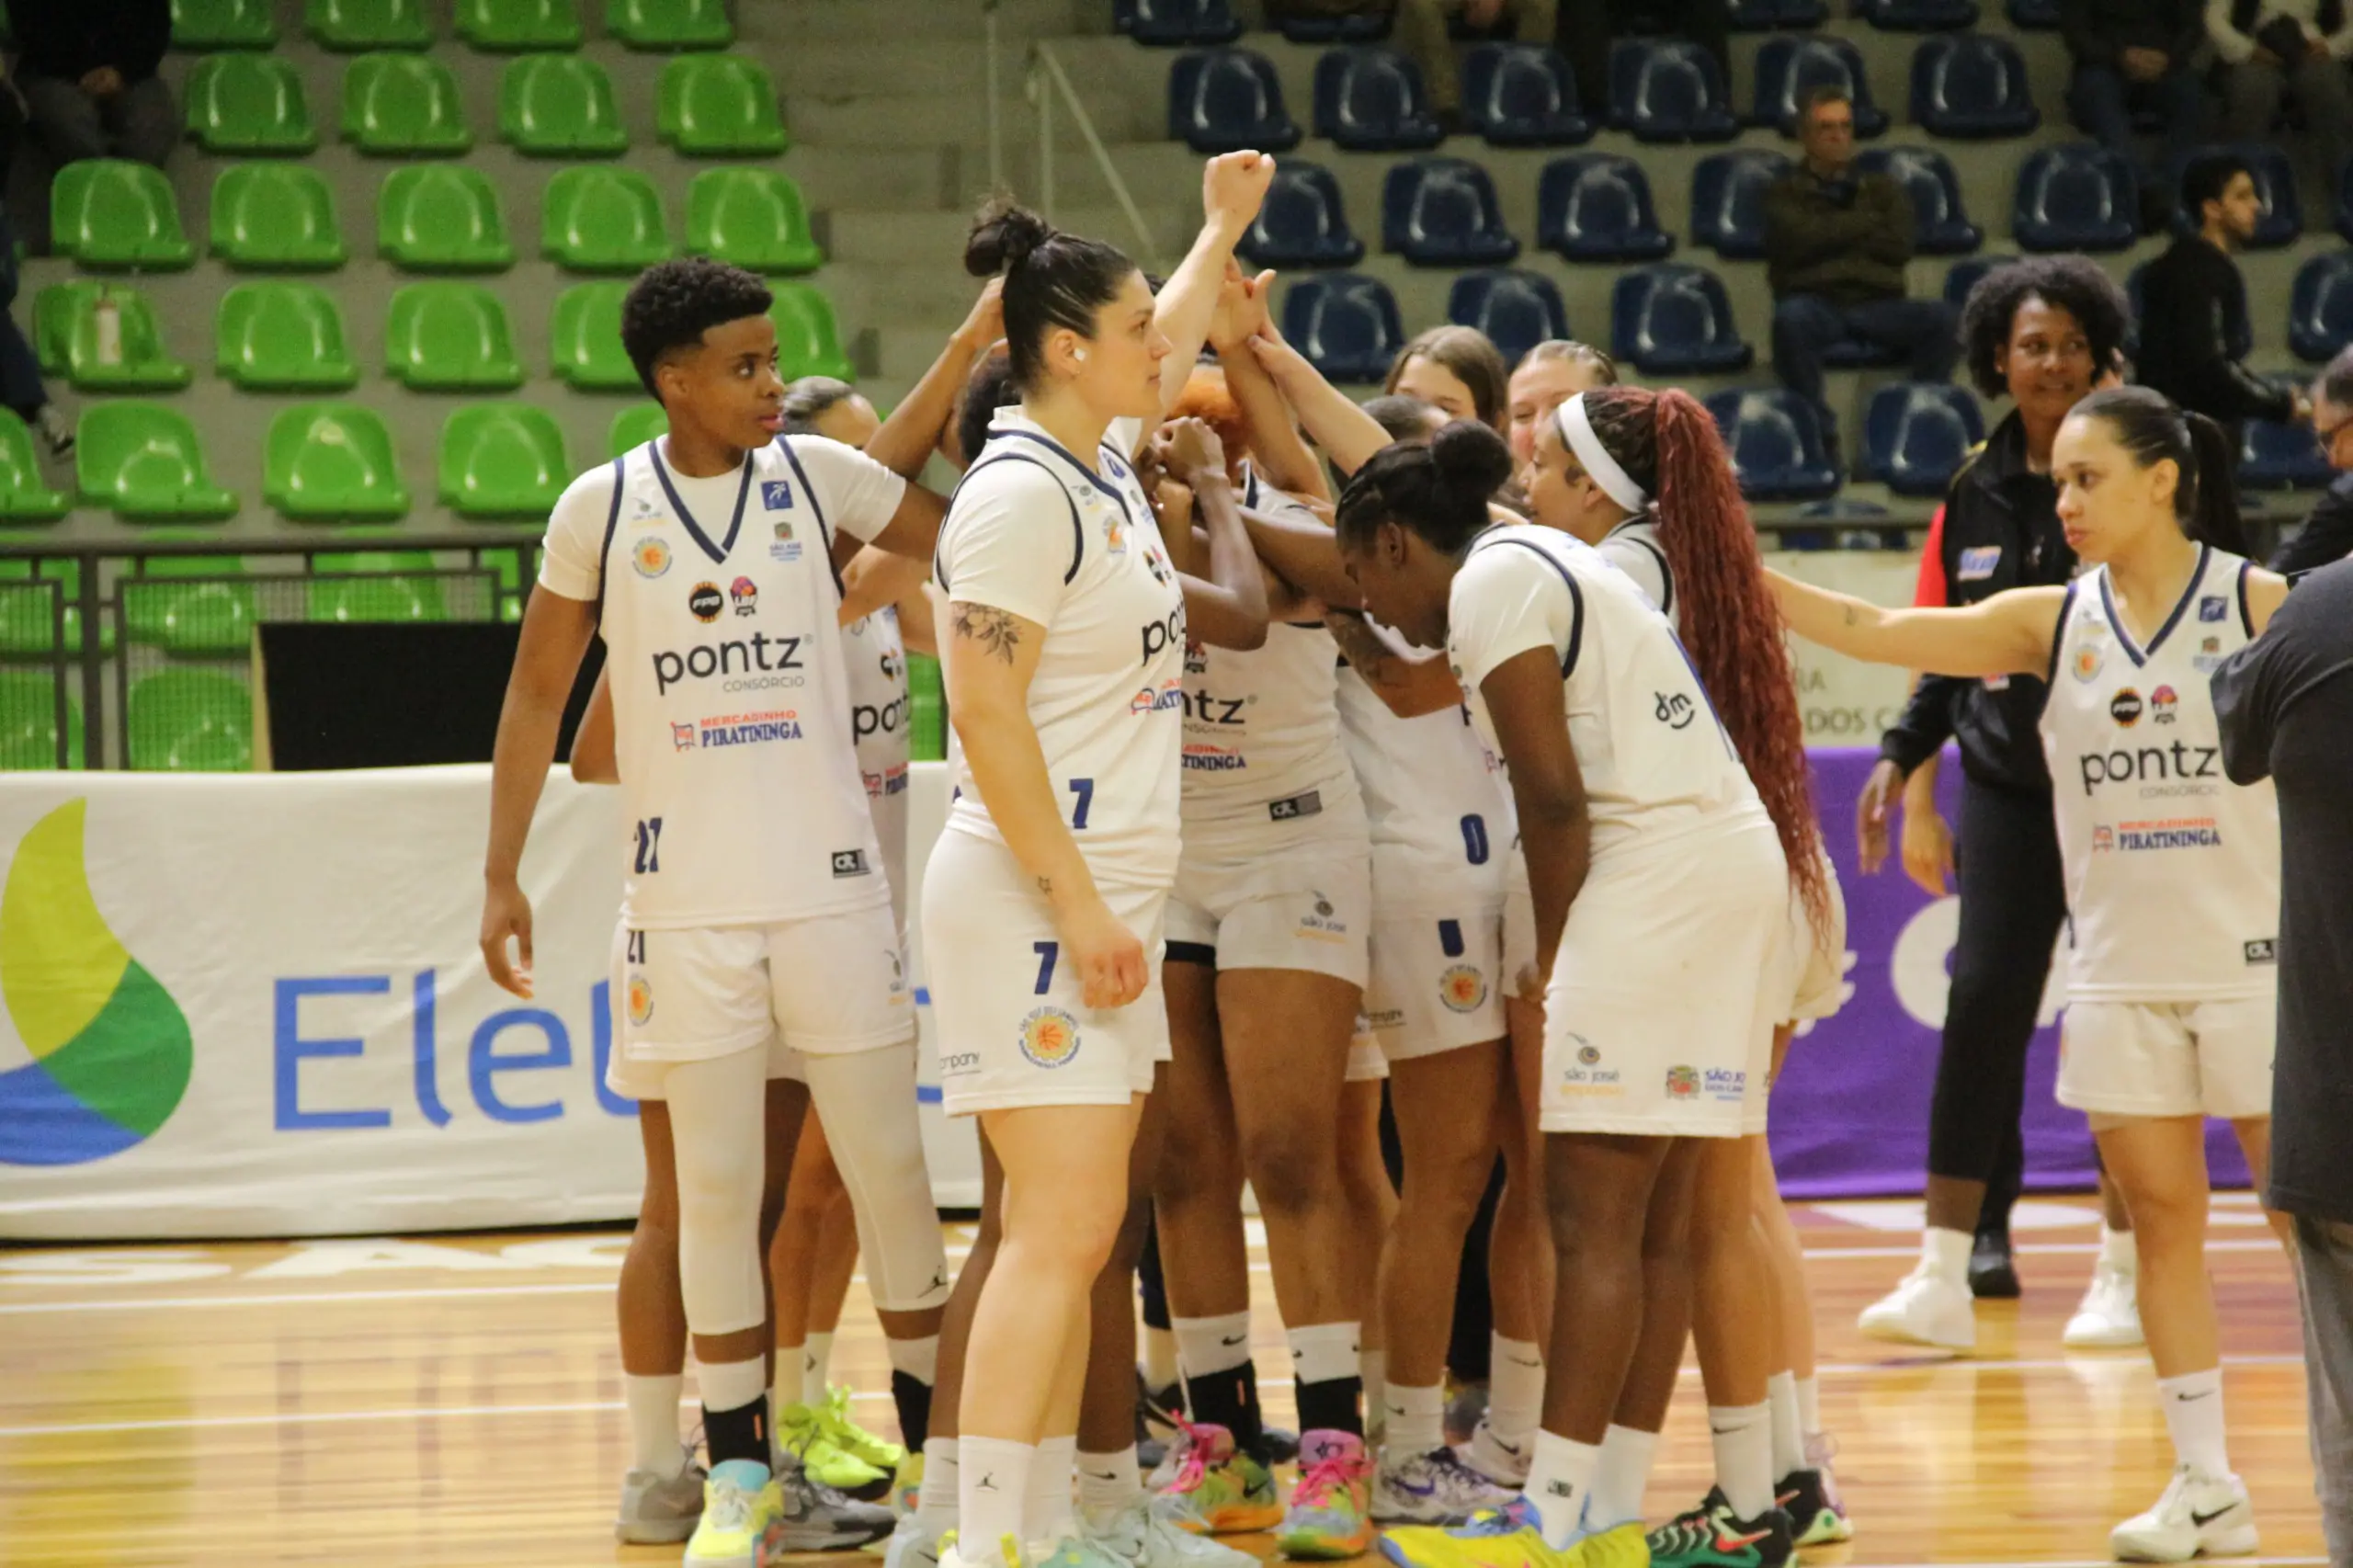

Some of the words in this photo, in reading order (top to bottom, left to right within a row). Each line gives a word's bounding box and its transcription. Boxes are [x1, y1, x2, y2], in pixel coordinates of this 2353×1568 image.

[652, 631, 803, 696] pontz
[699, 710, 797, 728] MERCADINHO
[701, 721, 802, 748] PIRATININGA
[1874, 707, 1905, 734] C
[2081, 739, 2219, 797] pontz
[1069, 778, 1094, 829] 7
[2120, 829, 2221, 851] PIRATININGA
[1033, 941, 1059, 994] 7
